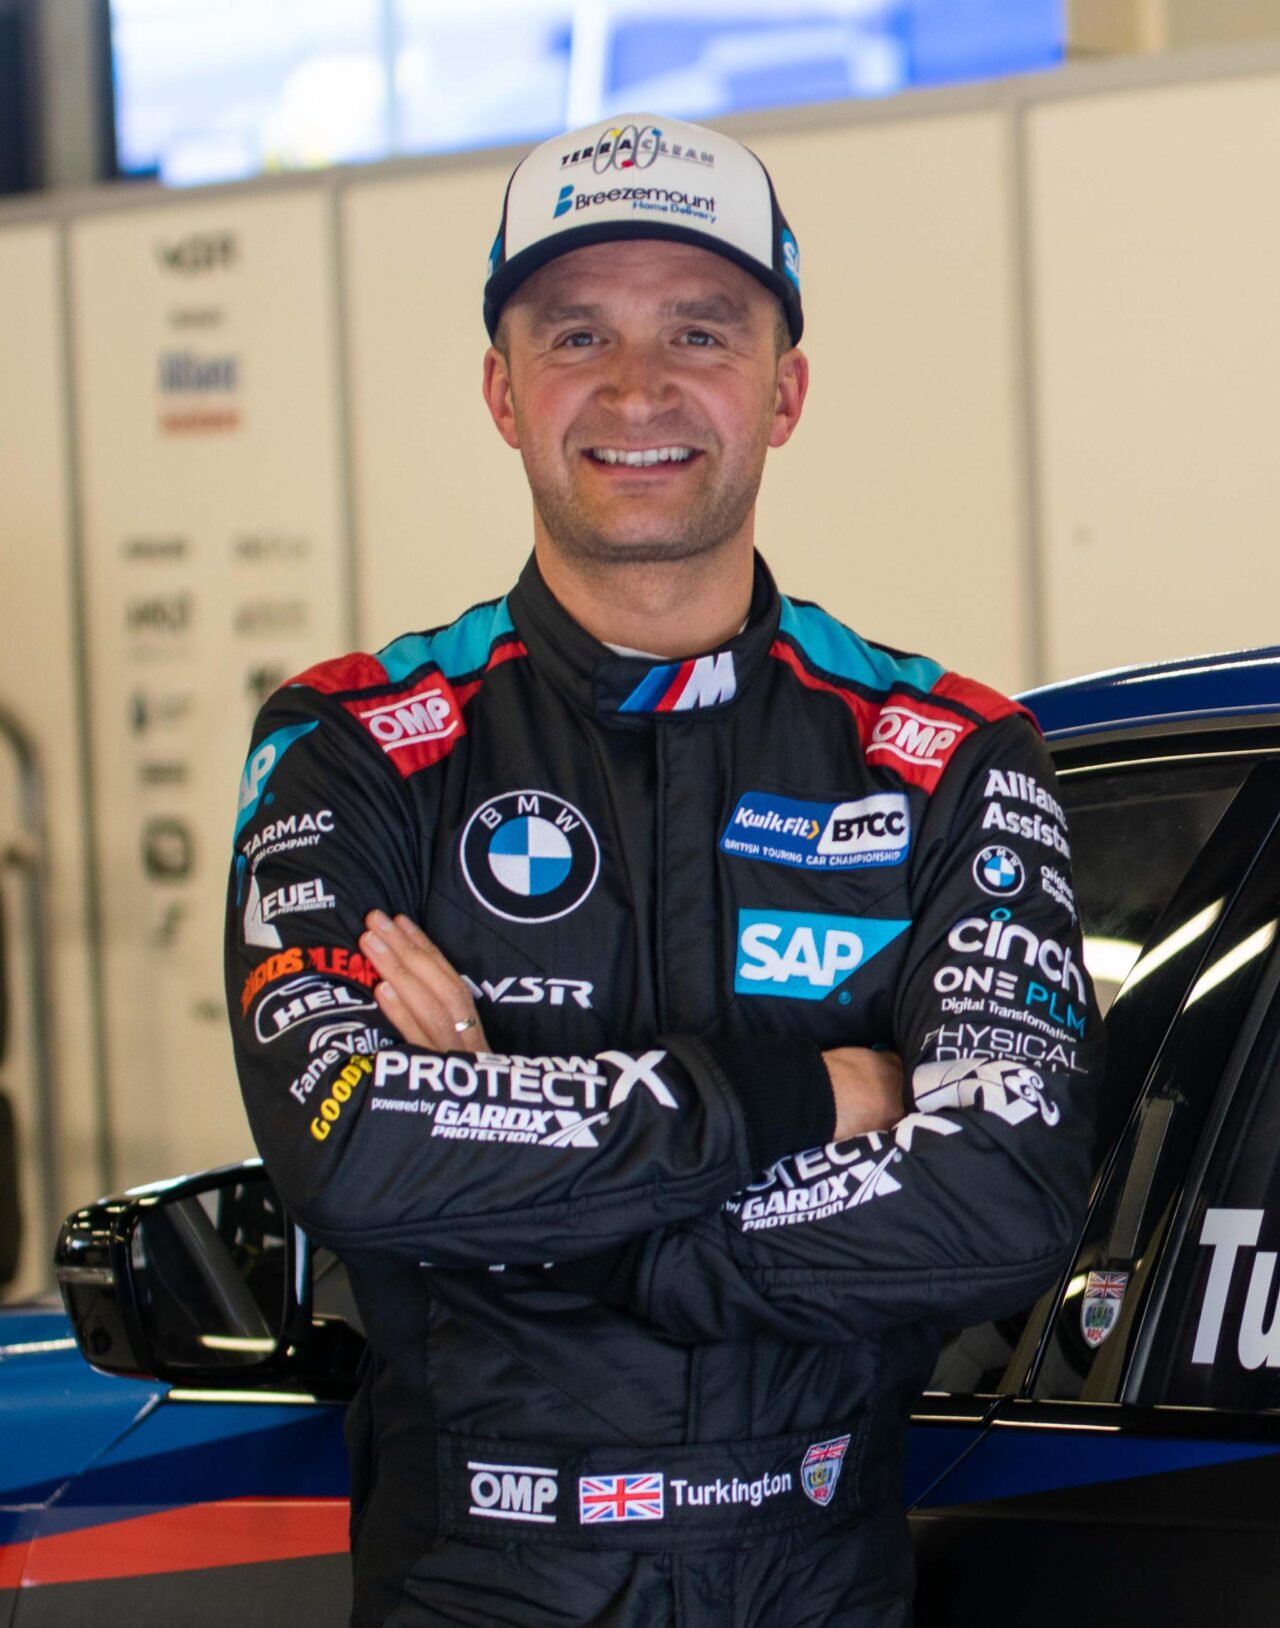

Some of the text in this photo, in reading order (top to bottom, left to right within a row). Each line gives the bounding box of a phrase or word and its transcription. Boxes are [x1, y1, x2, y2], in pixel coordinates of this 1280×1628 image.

[575, 187, 716, 213] Breezemount
[633, 200, 717, 224] Home Delivery
[368, 696, 451, 743] OMP
[871, 714, 958, 760] OMP
[242, 809, 335, 858] TARMAC
[480, 795, 581, 834] BMW
[831, 811, 906, 843] BTCC
[724, 838, 902, 867] BRITISH TOURING CAR CHAMPIONSHIP
[261, 878, 336, 921] FUEL
[739, 922, 864, 987] SAP
[947, 906, 1088, 1005] cinch
[272, 986, 362, 1030] HEL
[933, 965, 1087, 1039] ONE PLM
[941, 996, 985, 1014] Digital
[371, 1097, 420, 1114] powered
[420, 1100, 435, 1115] by
[431, 1124, 538, 1144] PROTECTION
[741, 1200, 844, 1233] PROTECTION
[469, 1470, 792, 1514] OMP Turkington
